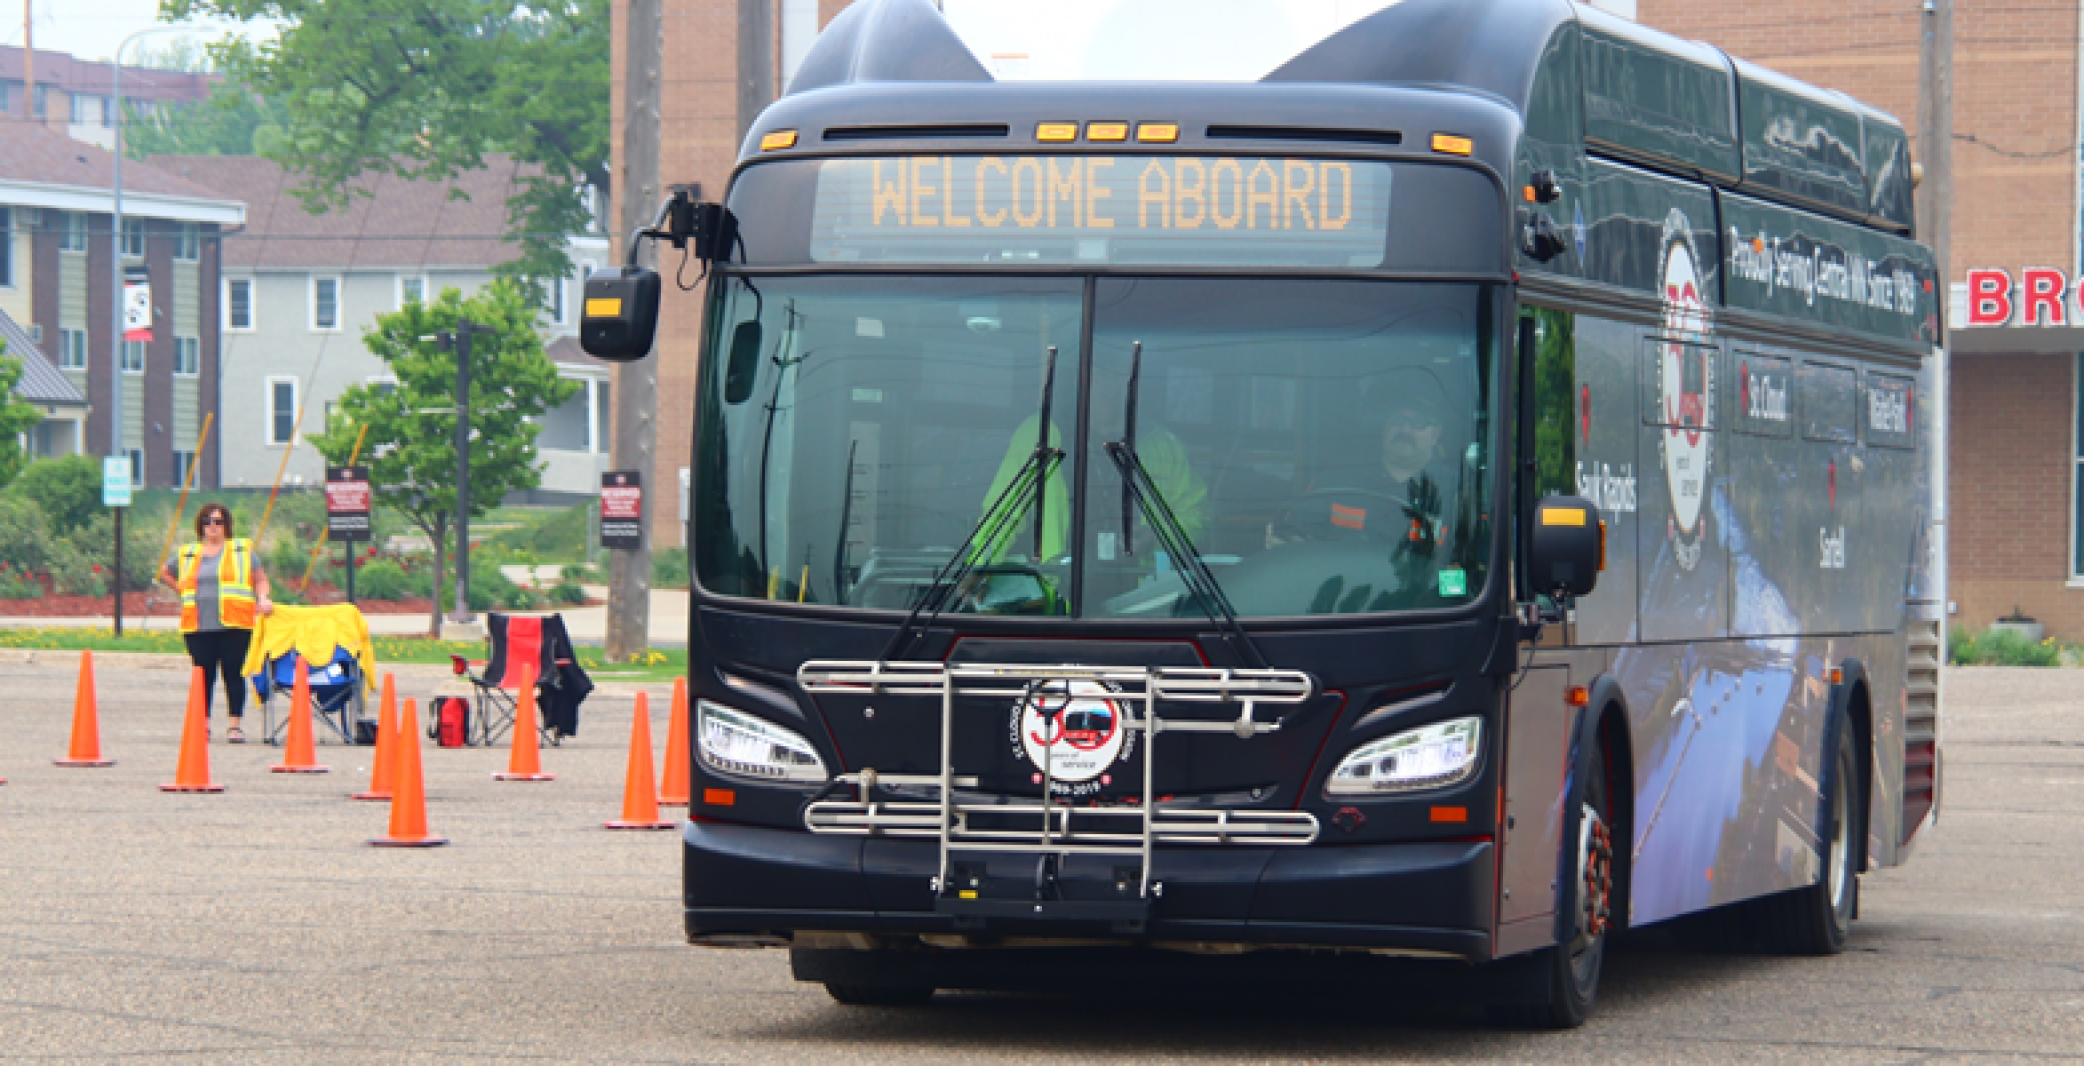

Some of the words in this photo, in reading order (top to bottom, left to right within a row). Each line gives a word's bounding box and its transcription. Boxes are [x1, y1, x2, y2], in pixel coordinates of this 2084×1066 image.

[872, 156, 1115, 228] WELCOME
[1137, 156, 1352, 230] ABOARD
[1774, 236, 1814, 307] Serving
[1967, 267, 2084, 326] BR
[1601, 462, 1637, 525] Rapids
[1046, 780, 1101, 796] 969-2019
